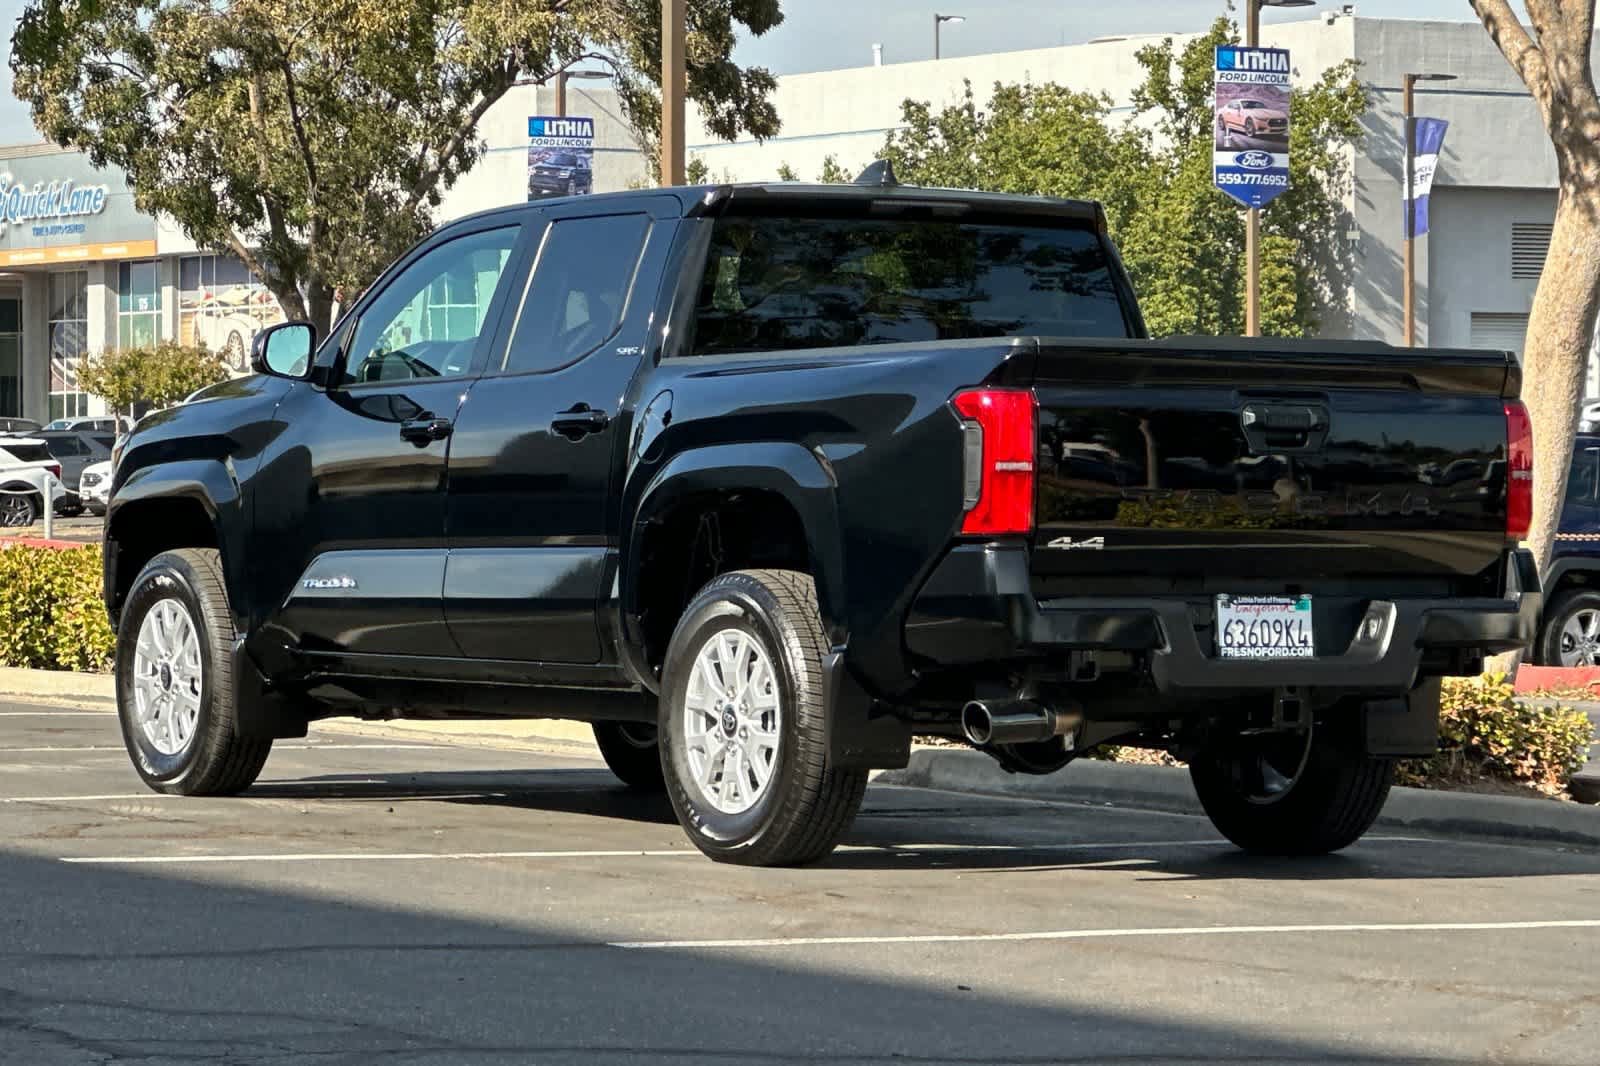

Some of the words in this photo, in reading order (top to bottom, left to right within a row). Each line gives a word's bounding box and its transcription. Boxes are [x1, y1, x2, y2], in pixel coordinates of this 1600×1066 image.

[1235, 50, 1288, 71] LITHIA
[1219, 72, 1248, 82] FORD
[1250, 73, 1288, 84] LINCOLN
[544, 120, 593, 136] LITHIA
[531, 138, 556, 146] FORD
[556, 138, 592, 147] LINCOLN
[1241, 152, 1269, 167] Ford
[1217, 173, 1287, 186] 559.777.6952
[7, 181, 58, 223] Quick
[58, 181, 105, 215] Lane
[1121, 488, 1440, 516] TAMA
[1047, 536, 1104, 550] 4x4
[1223, 618, 1308, 648] 63609K4
[1220, 647, 1313, 657] FRESNOFORD.COM
